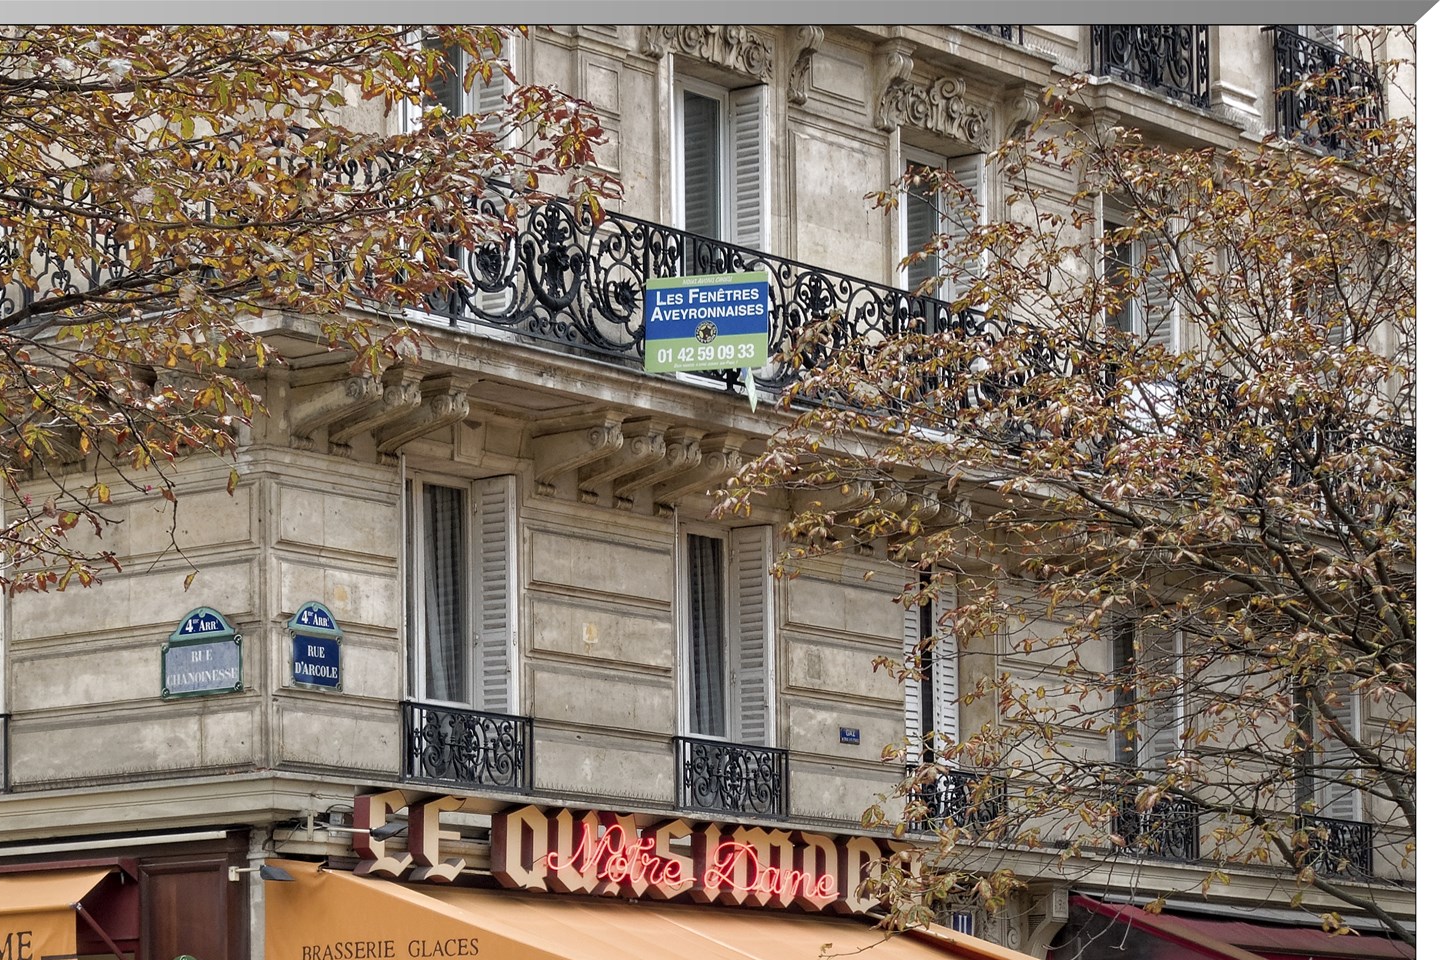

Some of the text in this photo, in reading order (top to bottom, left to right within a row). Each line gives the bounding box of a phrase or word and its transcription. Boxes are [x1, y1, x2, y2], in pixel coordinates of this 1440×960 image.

[657, 343, 755, 363] 01 42 59 09 33
[191, 649, 213, 663] RUE
[307, 645, 325, 659] RUE
[166, 667, 238, 687] CHANOINESSE
[294, 661, 338, 679] D'ARCOLE
[354, 791, 467, 885] LE
[547, 822, 840, 899] Notre Dame
[408, 938, 479, 958] GLACES
